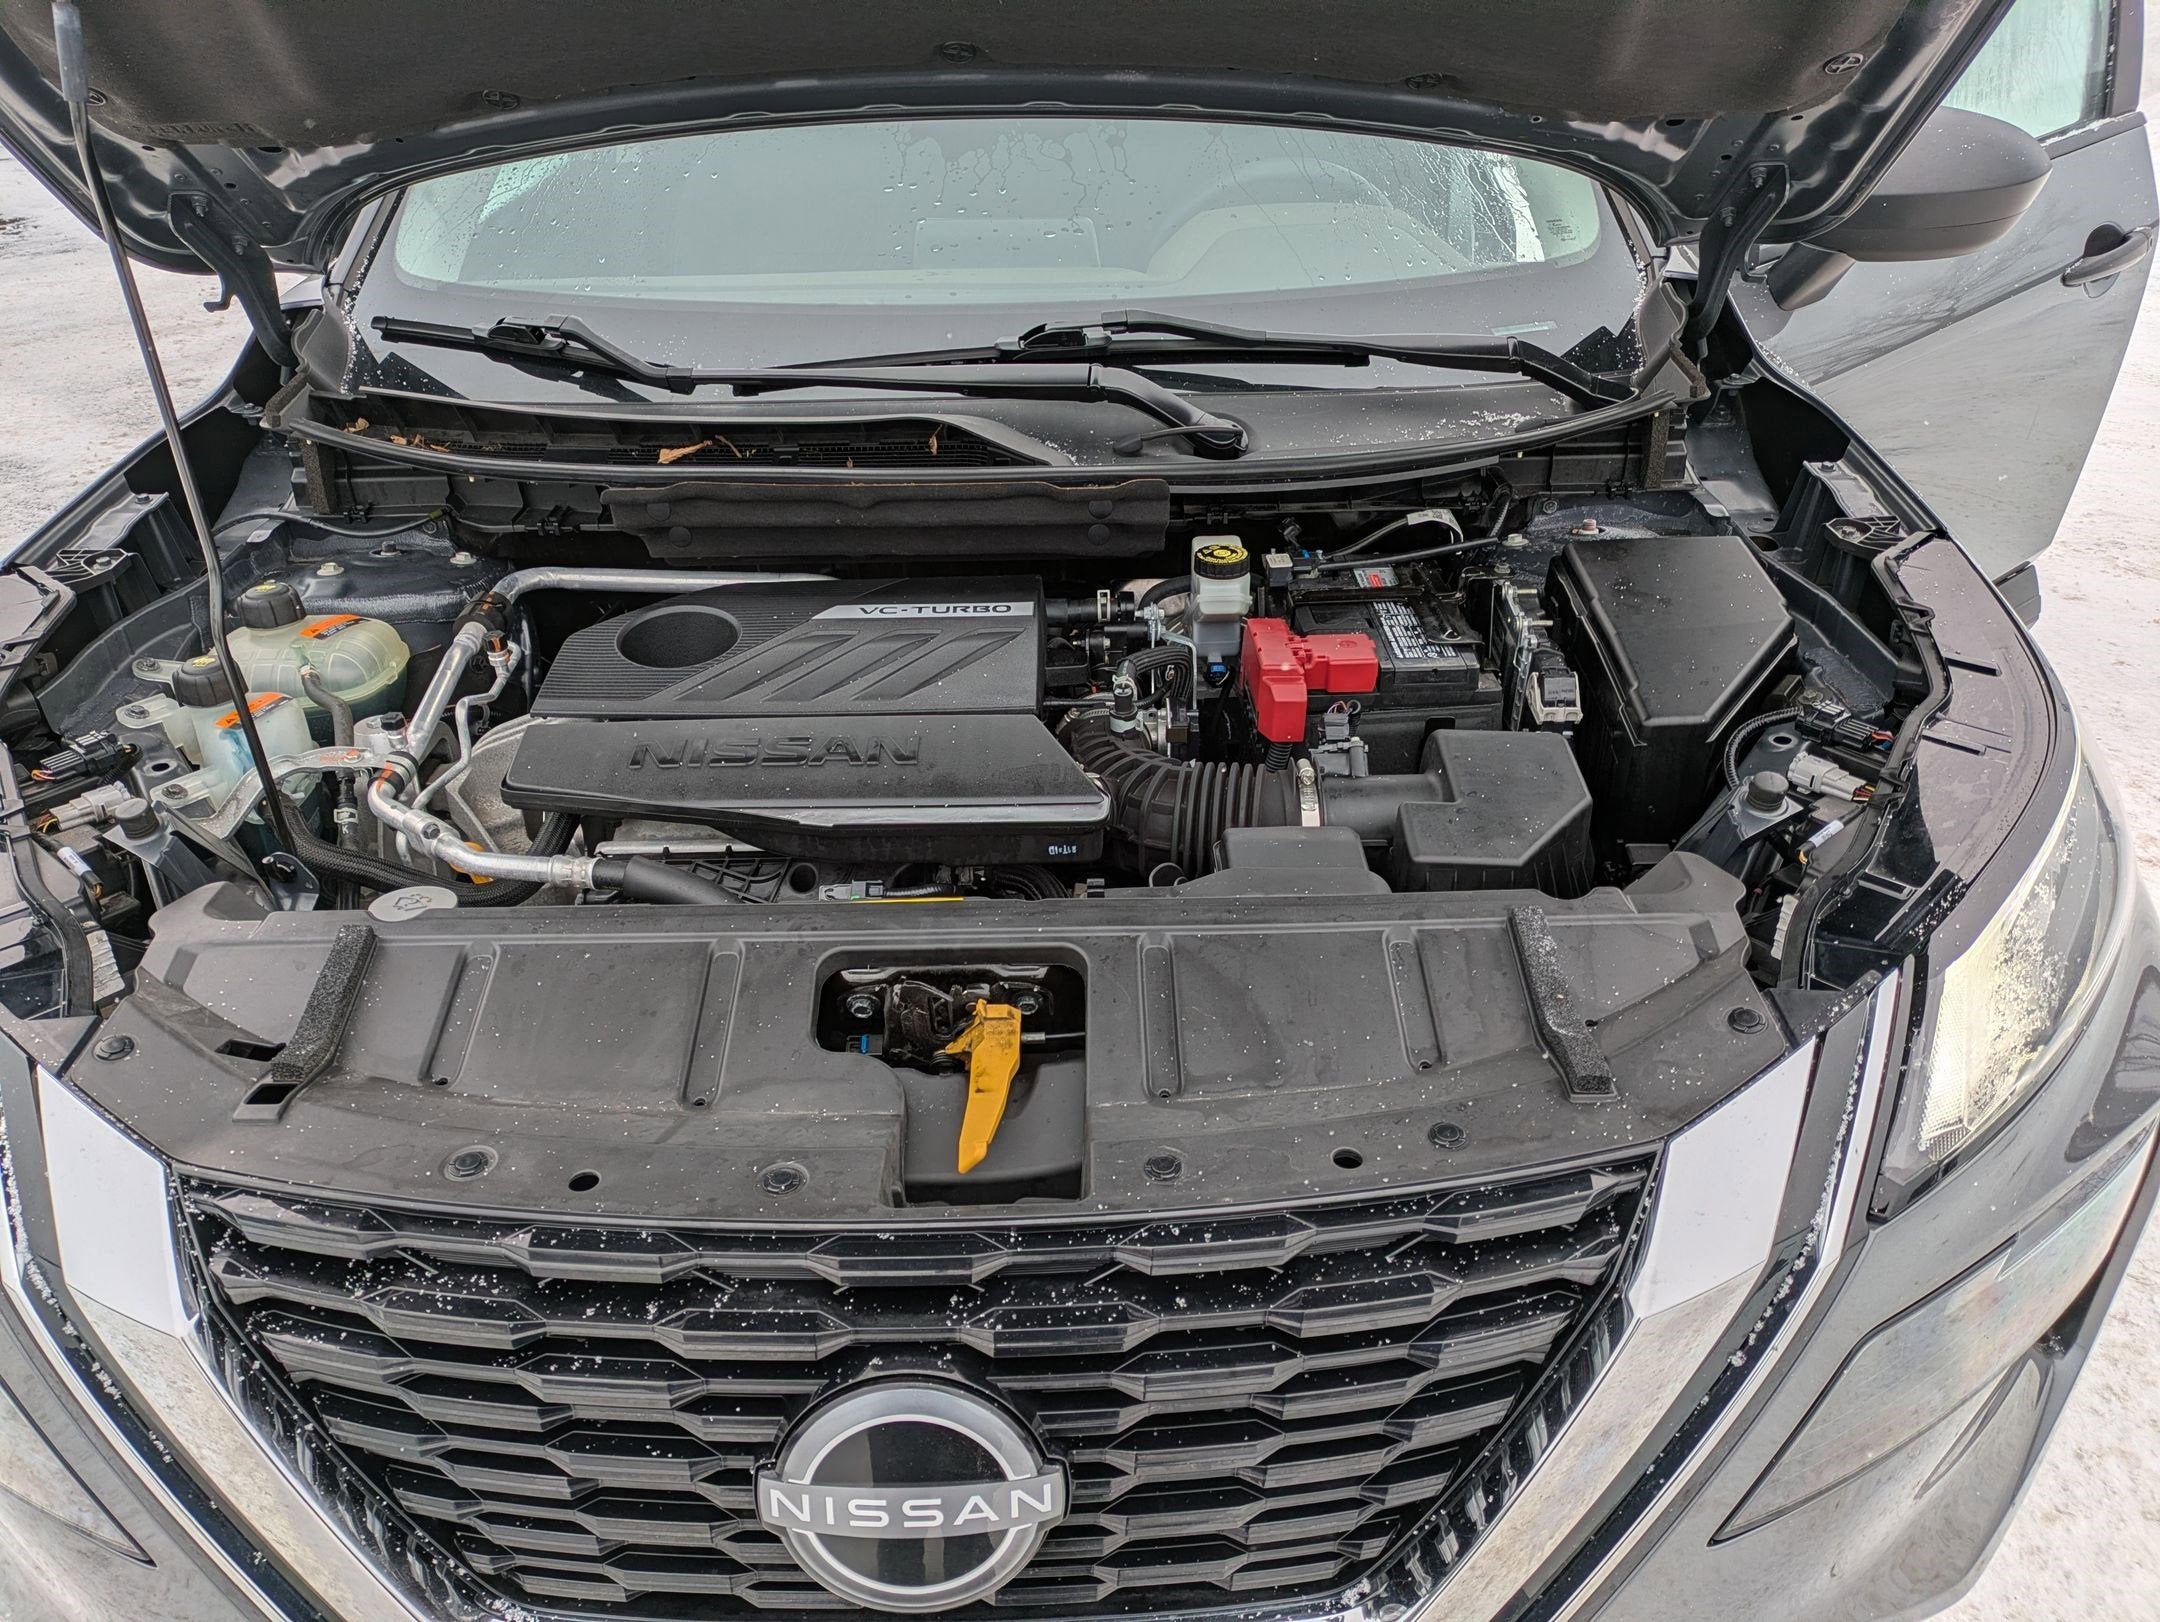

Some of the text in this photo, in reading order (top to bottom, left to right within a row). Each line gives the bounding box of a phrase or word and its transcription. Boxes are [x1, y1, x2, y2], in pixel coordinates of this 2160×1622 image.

[858, 603, 1012, 616] VC-TURBO
[627, 735, 921, 769] NISSAN
[769, 1482, 1052, 1528] NISSAN
